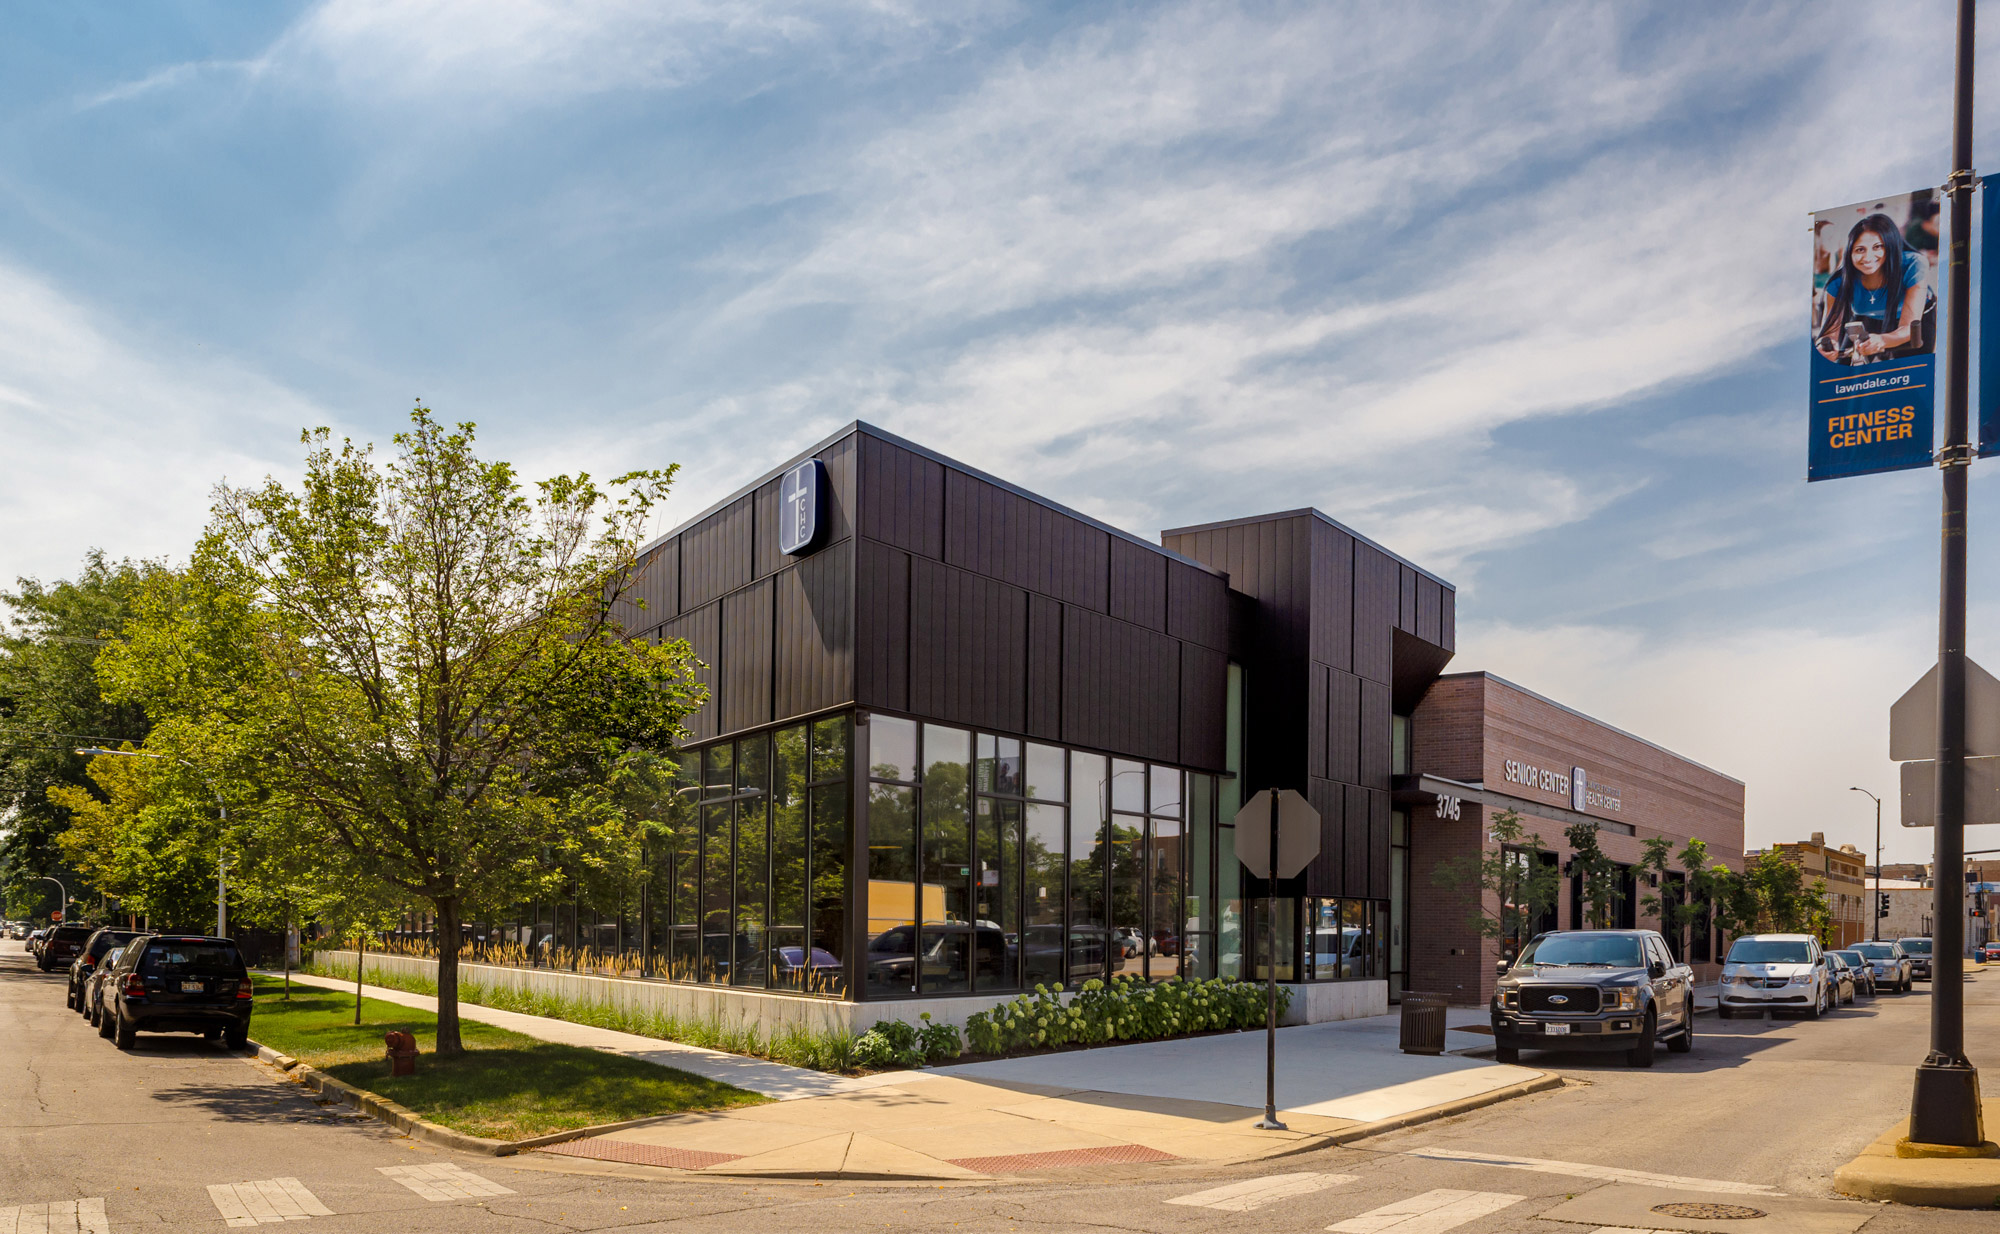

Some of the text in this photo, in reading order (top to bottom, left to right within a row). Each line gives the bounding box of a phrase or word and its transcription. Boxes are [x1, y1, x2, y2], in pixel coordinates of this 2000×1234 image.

[1835, 375, 1910, 394] lawndale.org
[1828, 405, 1915, 433] FITNESS
[1829, 422, 1913, 449] CENTER
[1505, 759, 1538, 788] SENIOR
[1539, 769, 1569, 796] CENTER
[1436, 794, 1461, 821] 3745
[1585, 790, 1621, 812] HEALTH CENTER
